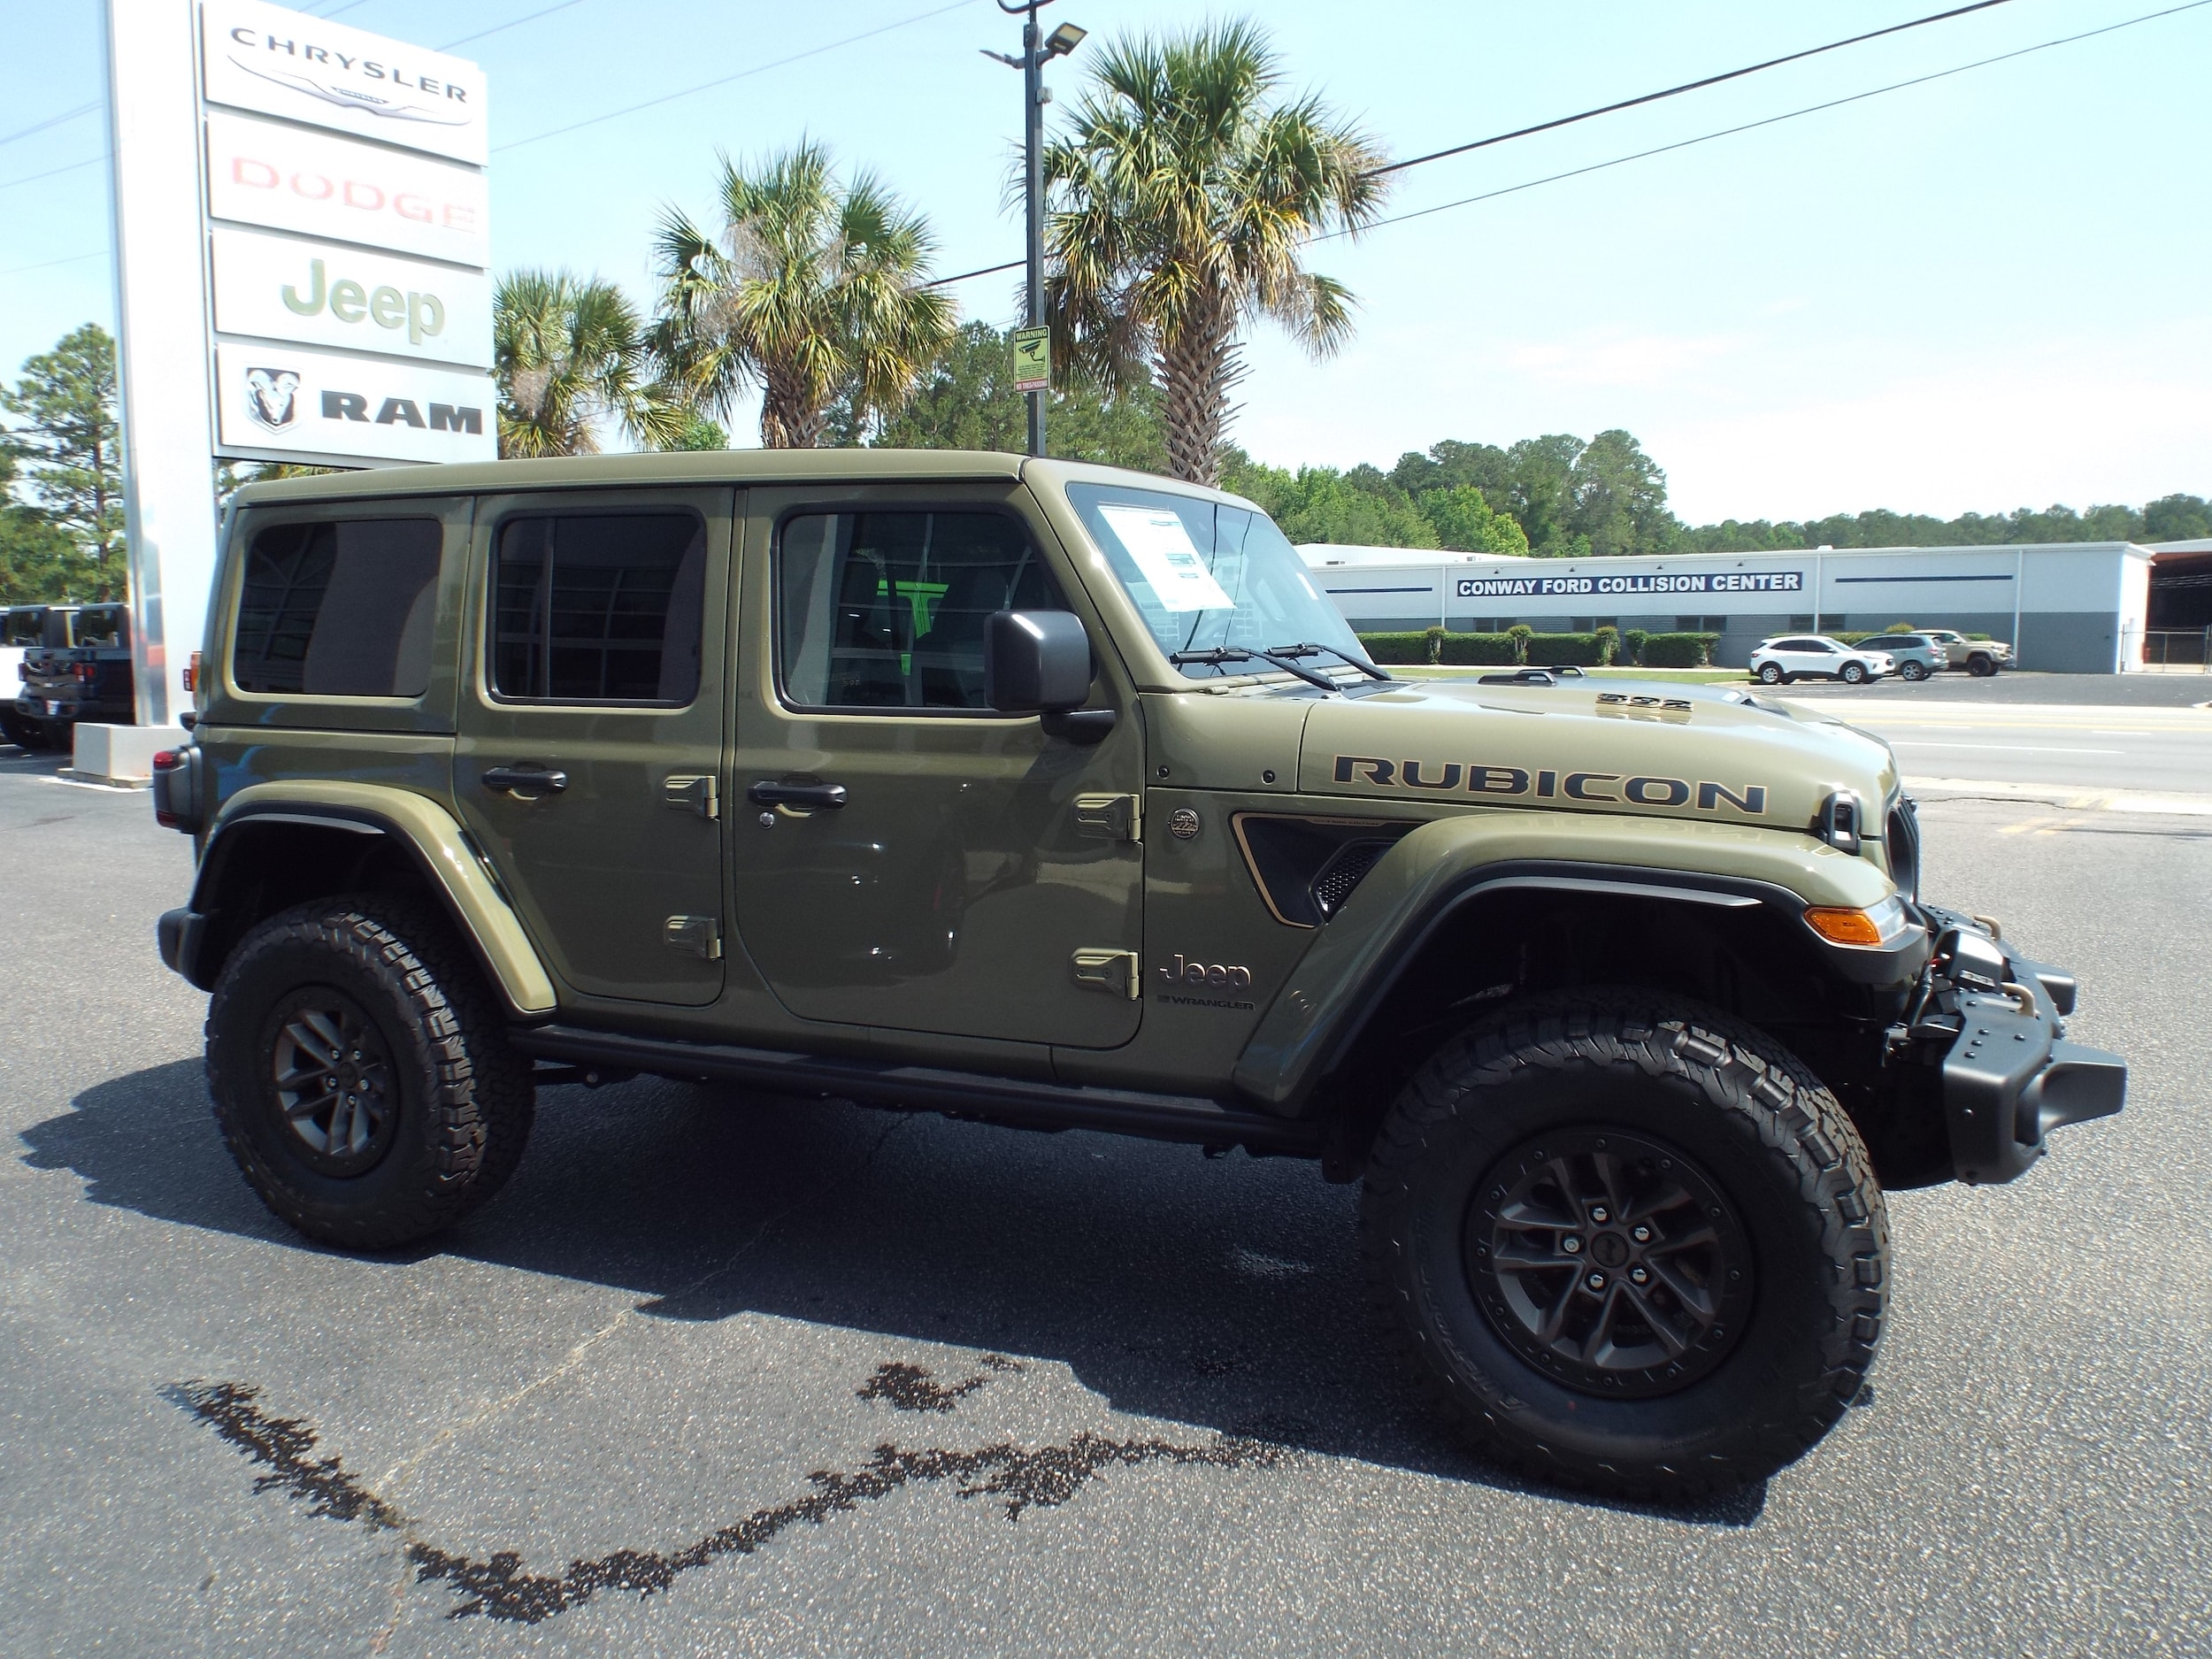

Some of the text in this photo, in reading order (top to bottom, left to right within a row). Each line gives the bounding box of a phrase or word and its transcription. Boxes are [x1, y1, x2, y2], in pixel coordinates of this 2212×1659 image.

[230, 27, 468, 104] CHRYSLER
[231, 156, 477, 234] DODGE
[280, 257, 446, 345] Jeep
[1016, 328, 1047, 340] WARNING
[320, 389, 484, 436] RAM
[1458, 573, 1799, 595] CONWAY FORD COLLISION CENTER
[1332, 754, 1768, 816] RUBICON
[1158, 953, 1251, 994] Jeep
[1171, 995, 1256, 1010] WRANGLER
